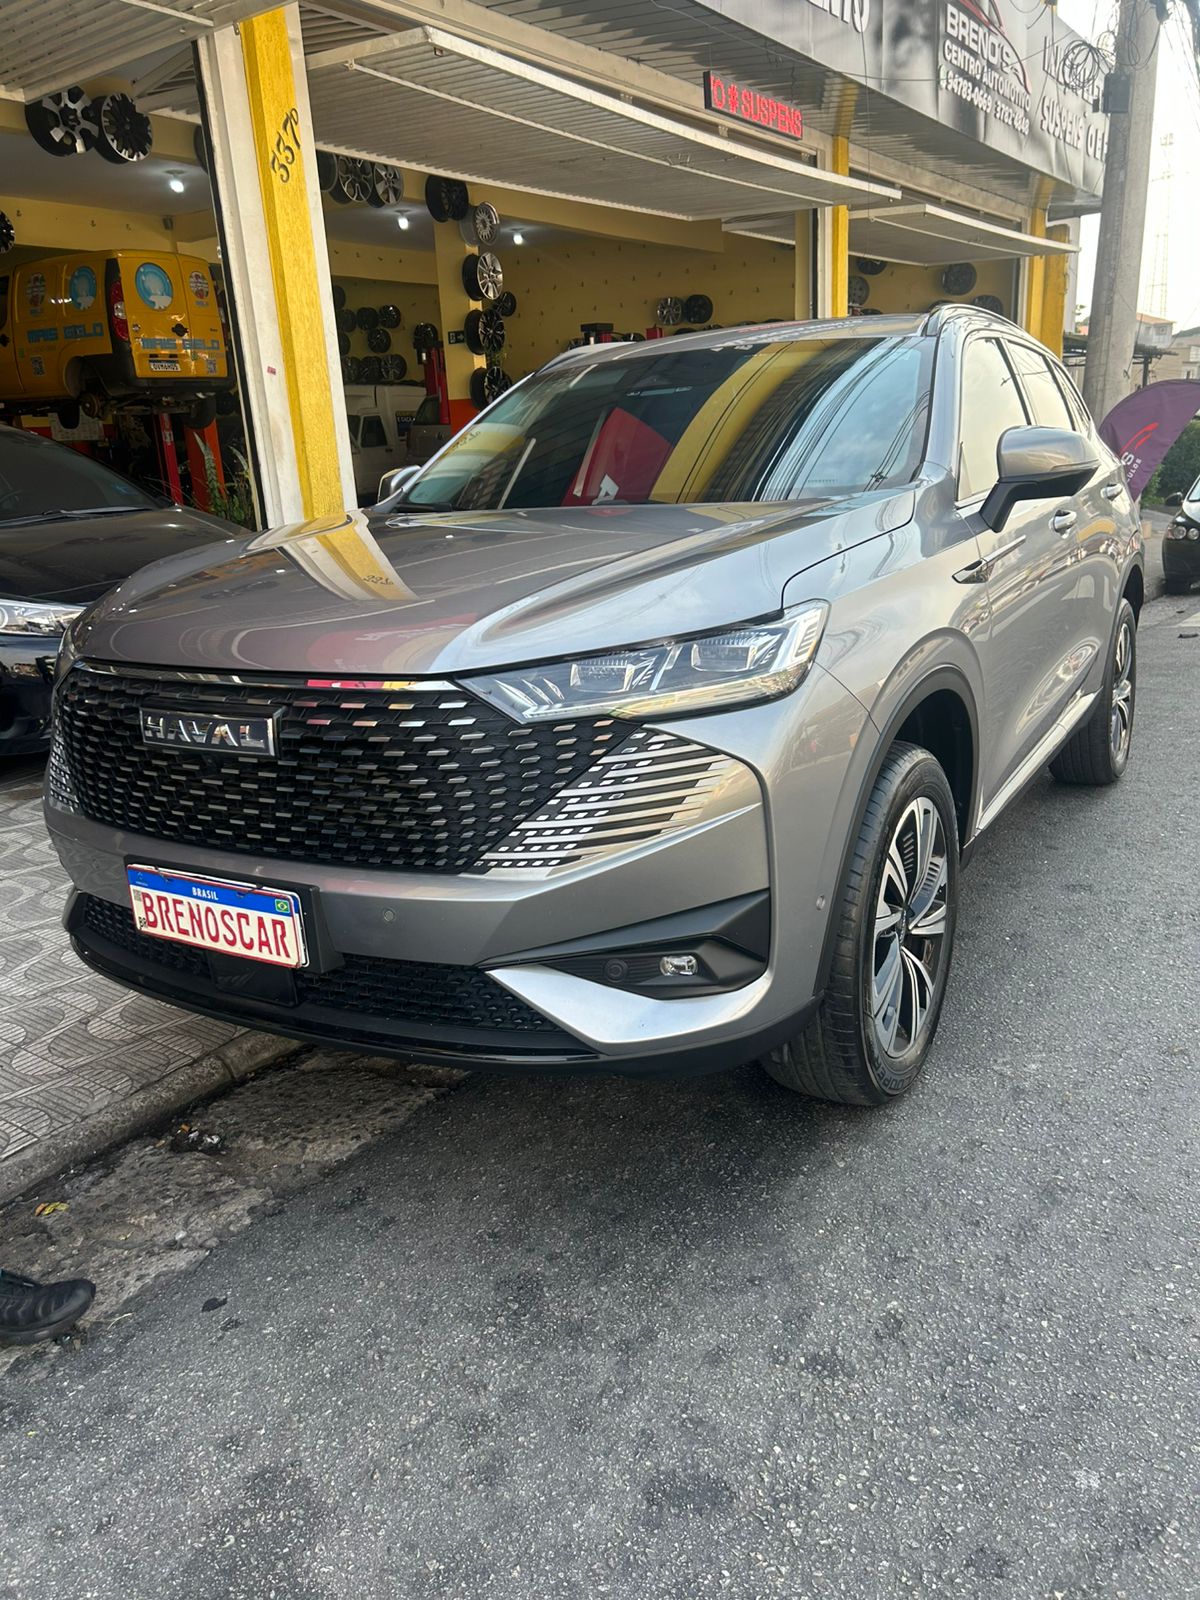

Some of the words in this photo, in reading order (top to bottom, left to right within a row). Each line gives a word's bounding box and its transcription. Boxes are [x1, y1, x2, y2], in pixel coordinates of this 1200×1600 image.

[946, 4, 1012, 74] BRENO'S
[944, 39, 981, 80] CENTRO
[983, 65, 1030, 112] AUTOMOTIVO
[741, 88, 802, 138] SUSPENS
[145, 715, 266, 749] HAVAL
[192, 886, 219, 901] BRASIL
[141, 892, 291, 959] BRENOSCAR
